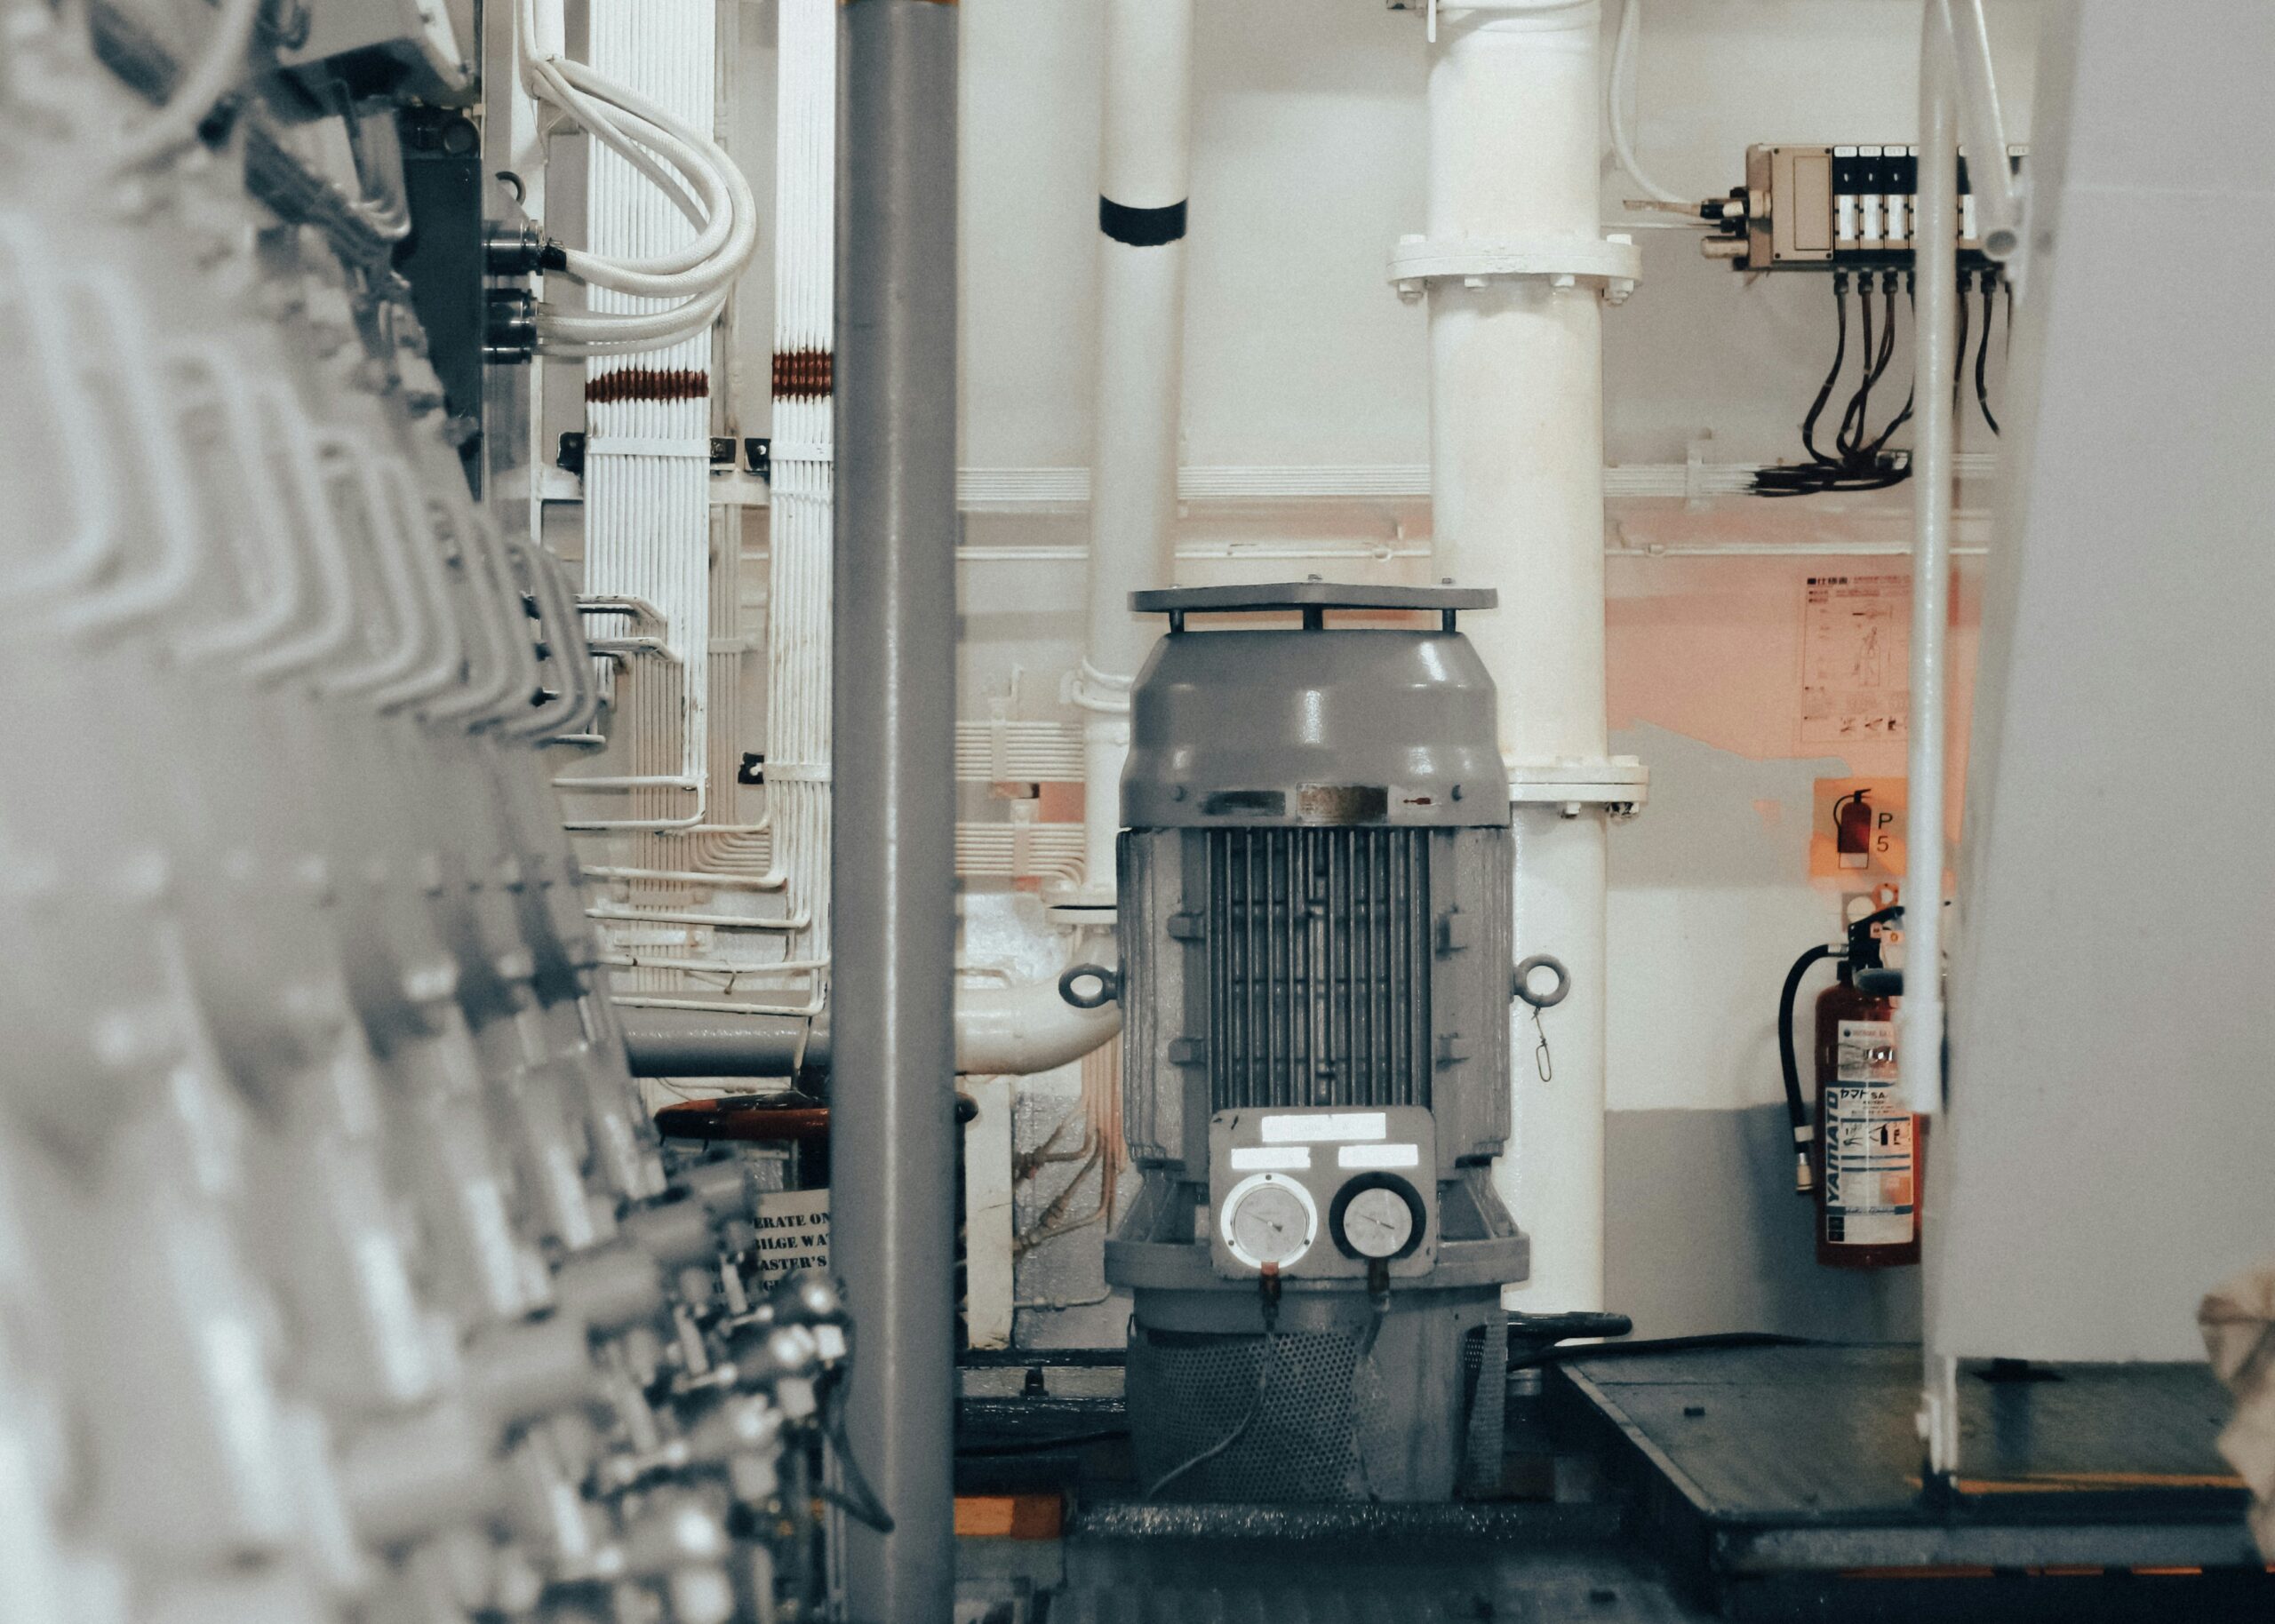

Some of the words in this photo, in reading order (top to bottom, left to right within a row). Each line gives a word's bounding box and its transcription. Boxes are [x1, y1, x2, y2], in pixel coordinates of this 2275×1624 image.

[1878, 813, 1893, 830] P
[1877, 836, 1889, 853] 5
[1840, 1089, 1867, 1099] ヤマト
[1827, 1090, 1840, 1204] YAMATO
[802, 1234, 829, 1247] WA
